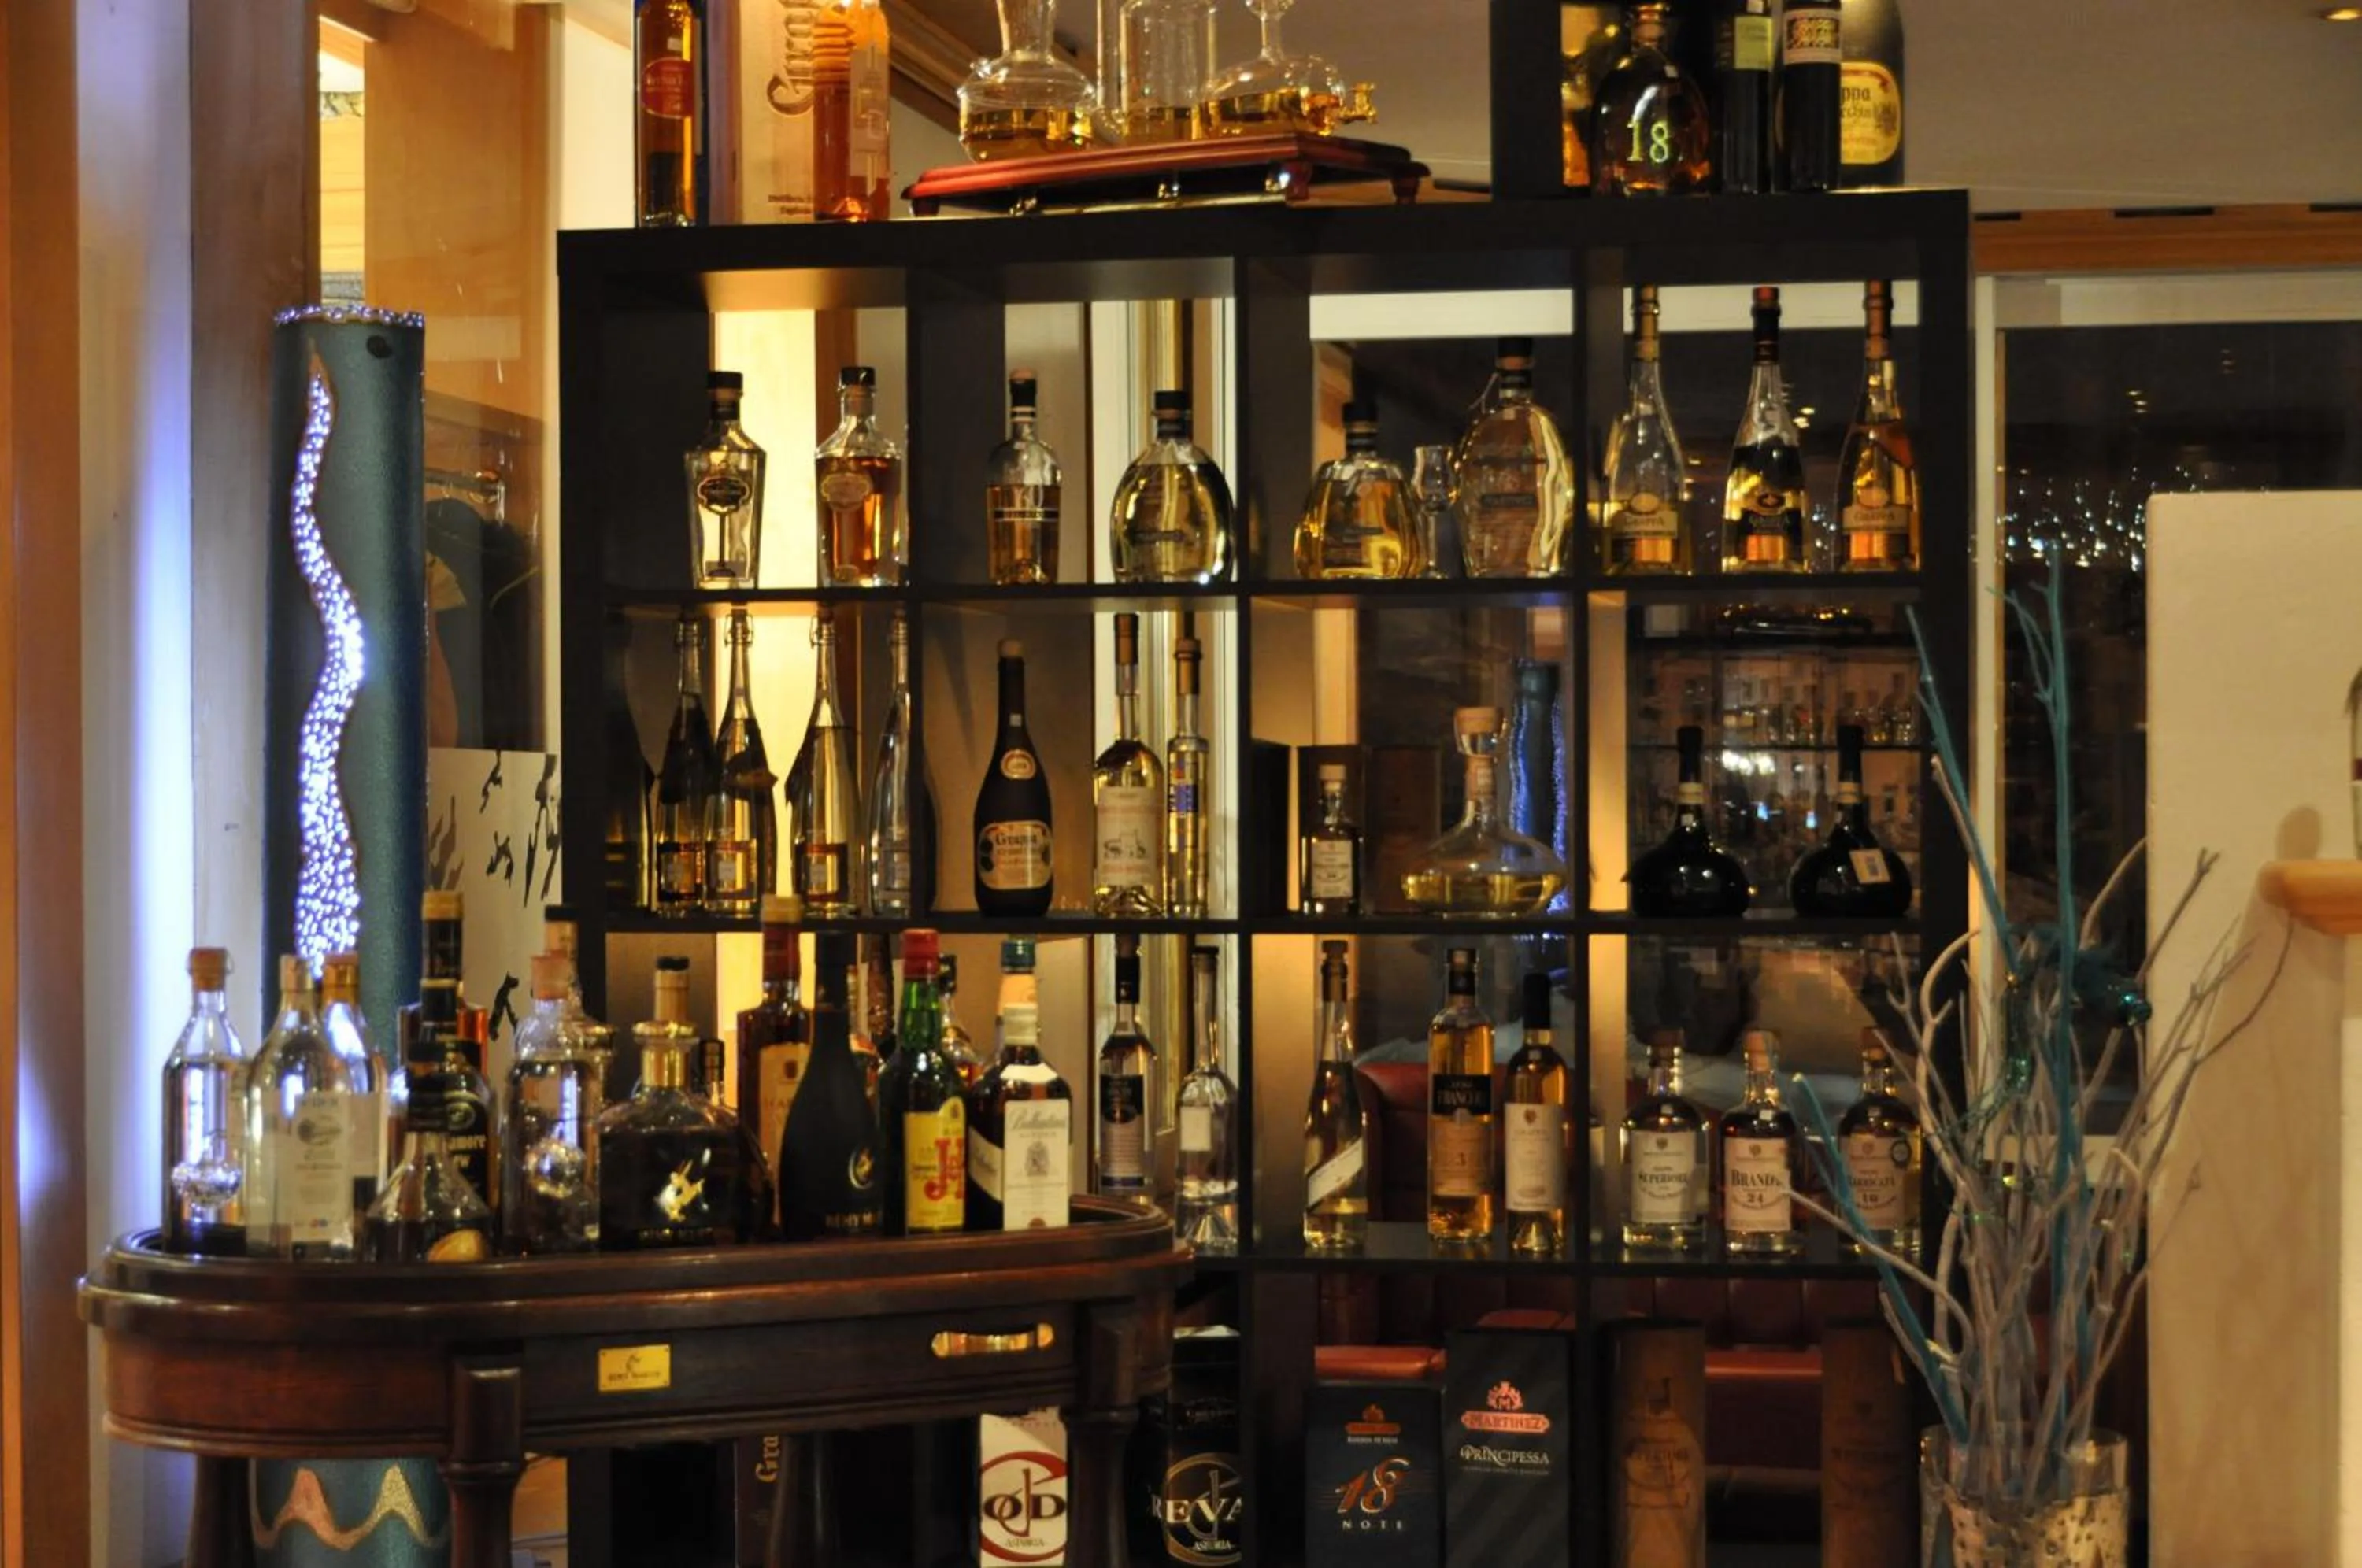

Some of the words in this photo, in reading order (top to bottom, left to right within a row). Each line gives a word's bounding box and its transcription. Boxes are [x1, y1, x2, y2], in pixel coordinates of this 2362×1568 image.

[1841, 87, 1872, 104] ppa
[1627, 118, 1668, 162] 18
[1460, 1444, 1549, 1466] PRINCIPESSA
[1335, 1456, 1411, 1514] 18
[1342, 1518, 1406, 1532] NOTE
